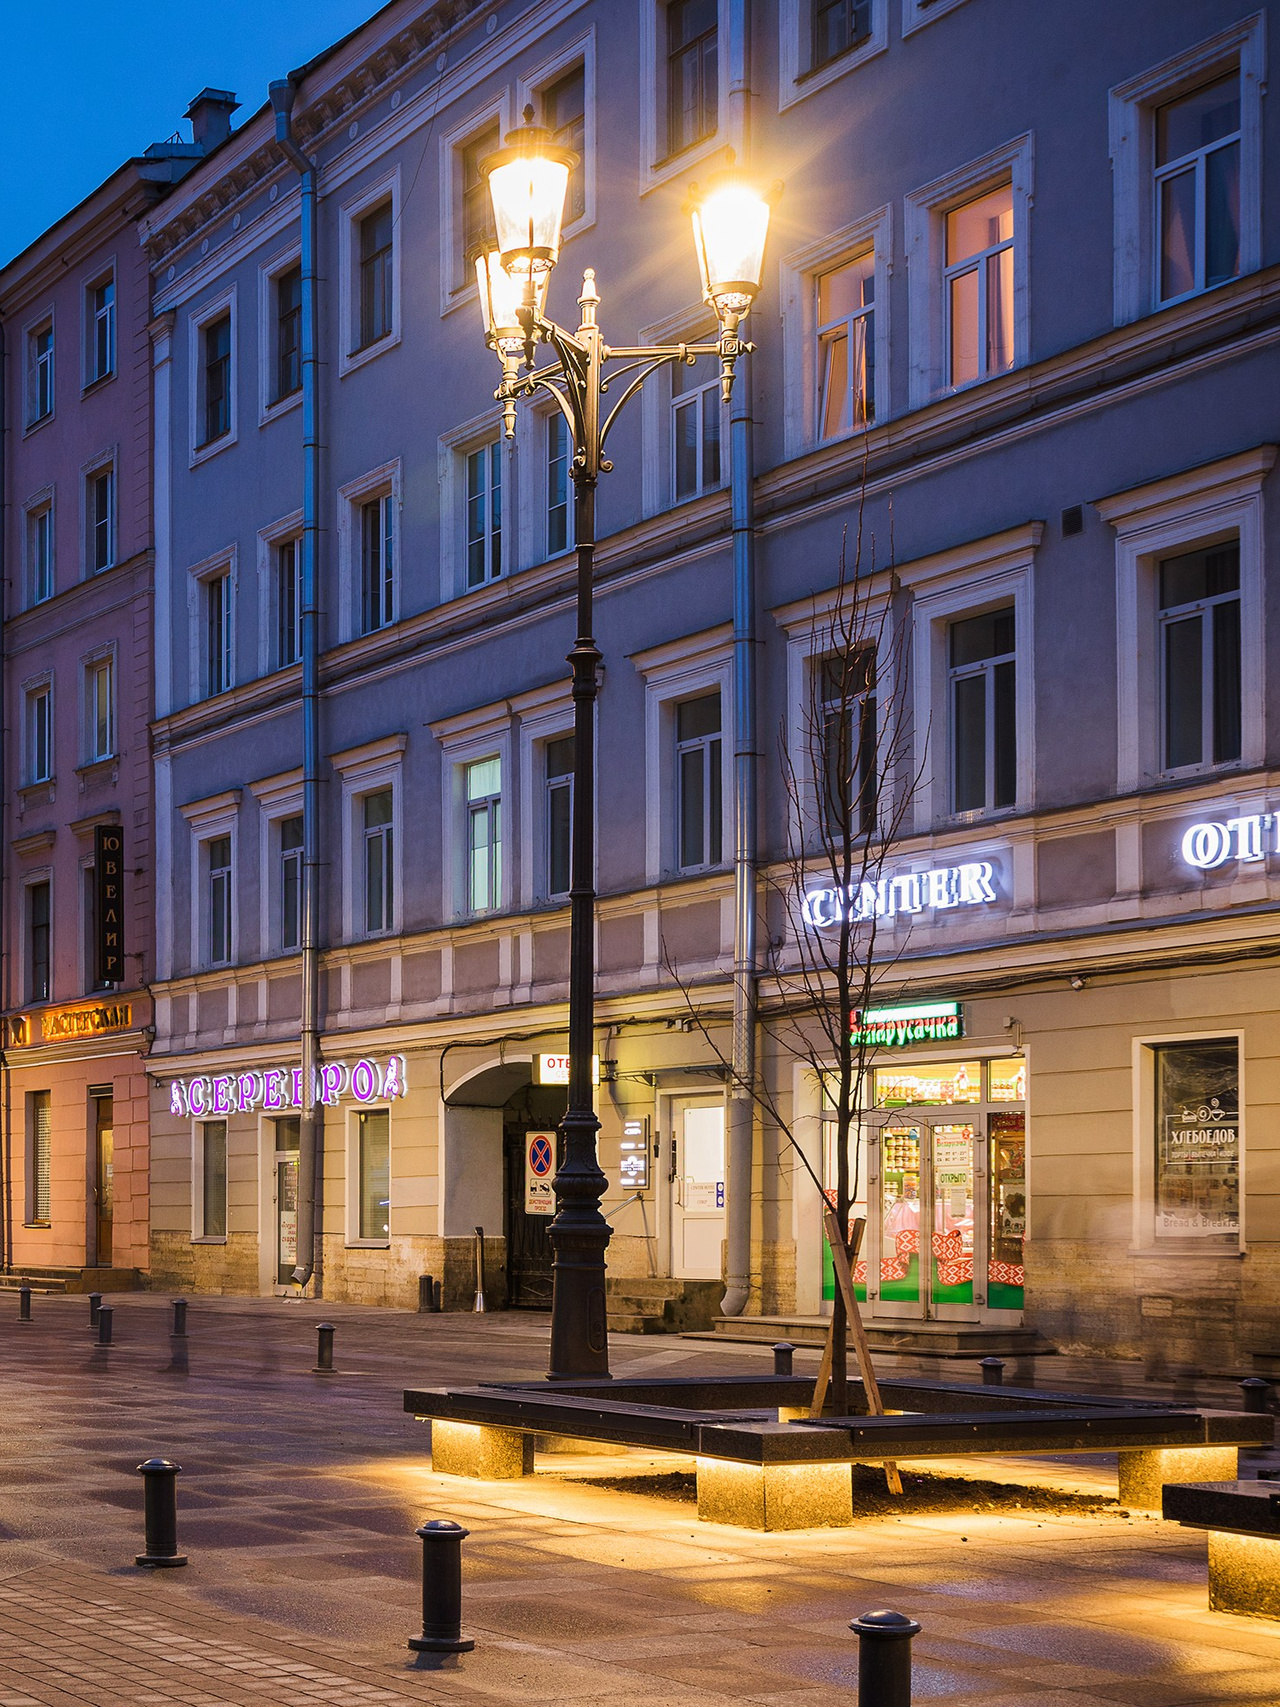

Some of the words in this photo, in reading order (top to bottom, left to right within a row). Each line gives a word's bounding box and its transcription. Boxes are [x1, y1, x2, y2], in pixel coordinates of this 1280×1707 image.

[101, 836, 120, 971] ЮВЕЛИР
[40, 1004, 131, 1038] МАСТЕРСКАЯ
[547, 1057, 571, 1069] ОТЕ
[1171, 1128, 1236, 1146] ХЛЕБОЕДОВ
[941, 1173, 967, 1183] ОТКРЫТО
[1163, 1217, 1189, 1228] Bread
[1192, 1217, 1200, 1228] &
